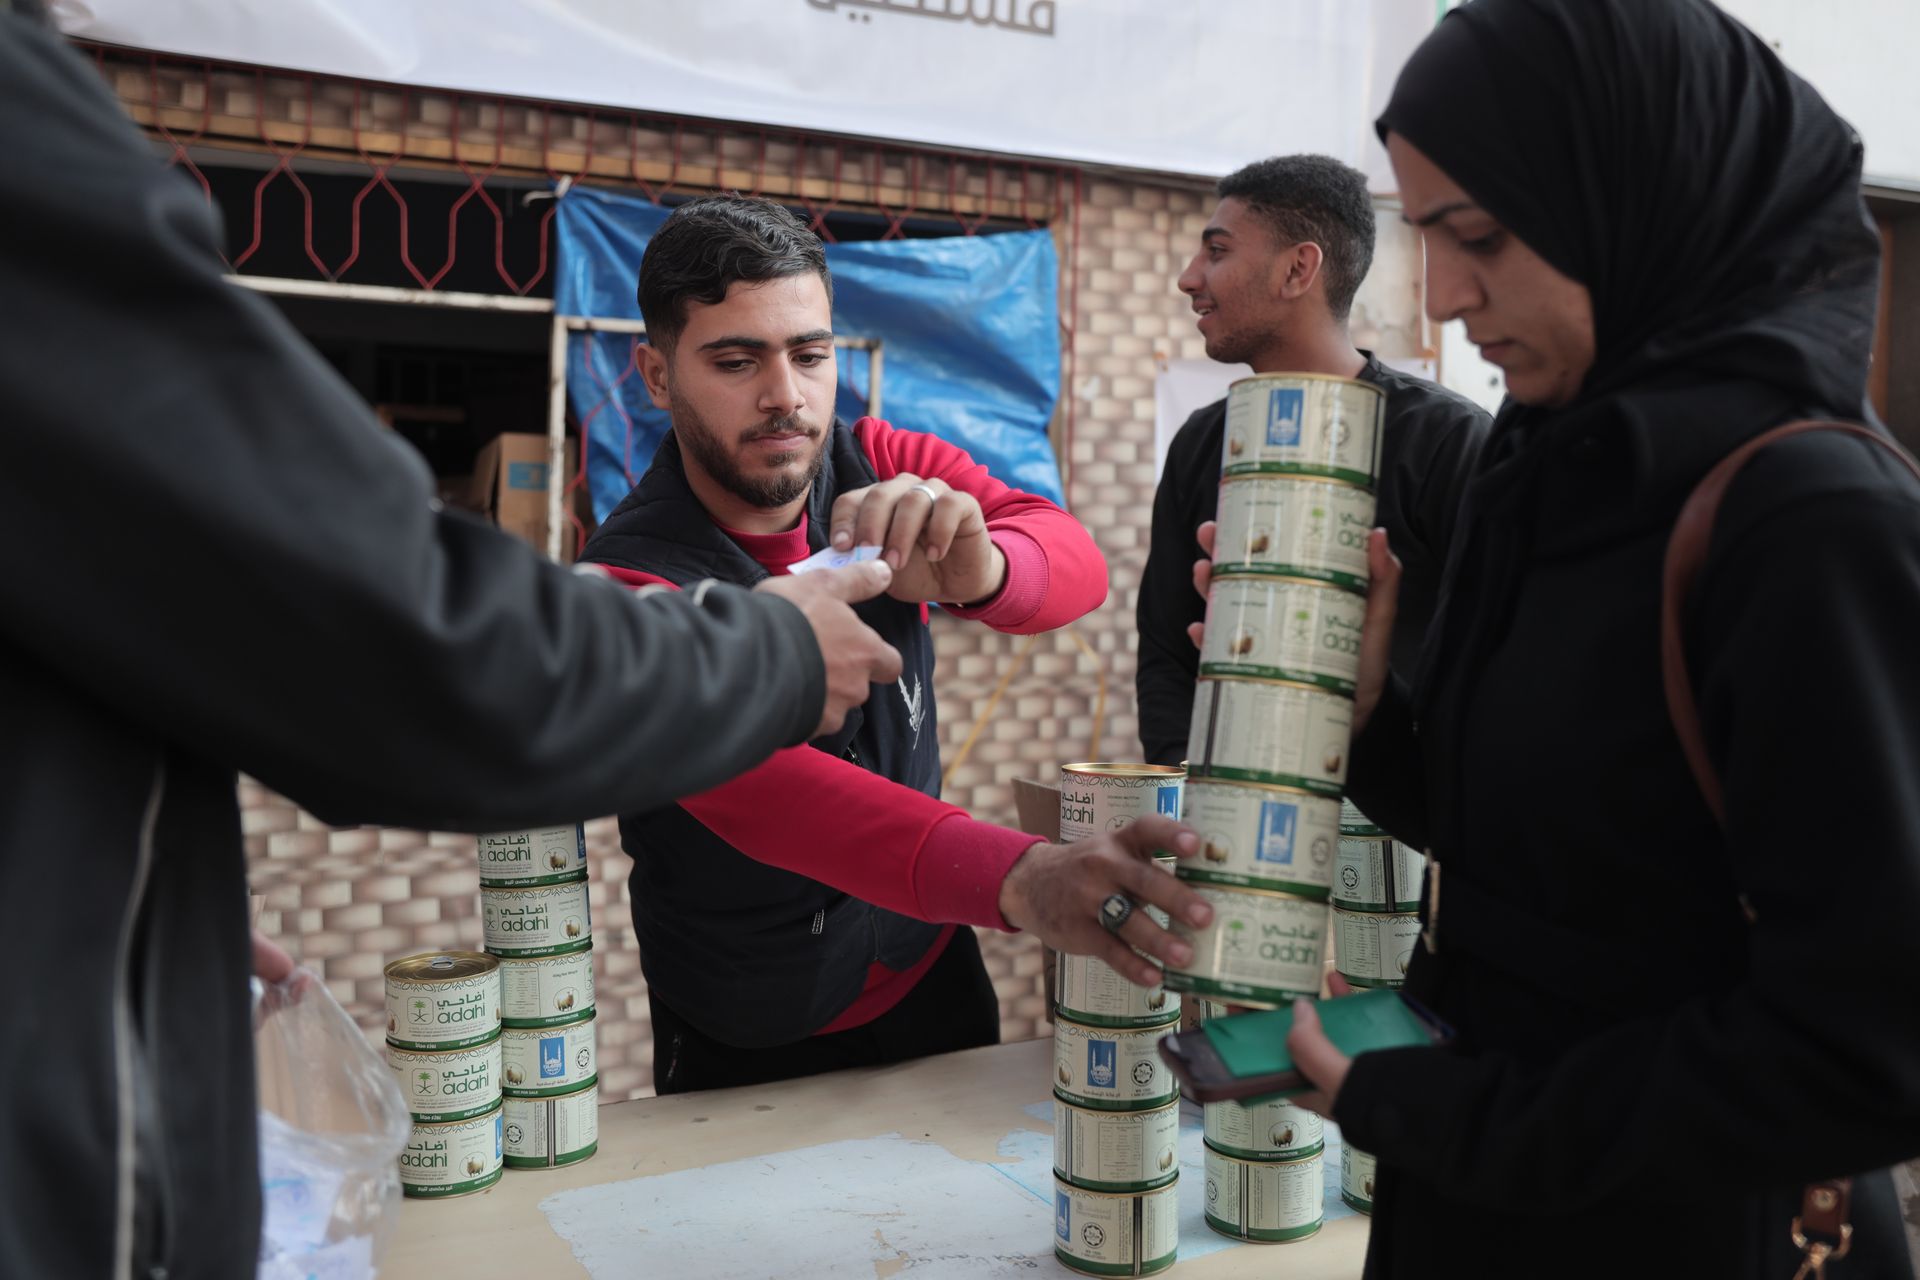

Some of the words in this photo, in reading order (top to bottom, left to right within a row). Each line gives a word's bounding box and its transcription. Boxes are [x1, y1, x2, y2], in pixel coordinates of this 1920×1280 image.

[488, 847, 531, 862] adahi
[500, 903, 548, 918] أضاحي
[502, 916, 548, 932] adahi
[436, 989, 485, 1009] أضاحي
[438, 1003, 486, 1024] adahi
[442, 1060, 488, 1081] أضاحي
[442, 1073, 489, 1095] adahi
[408, 1140, 448, 1150] أضاح
[400, 1153, 448, 1168] adahi
